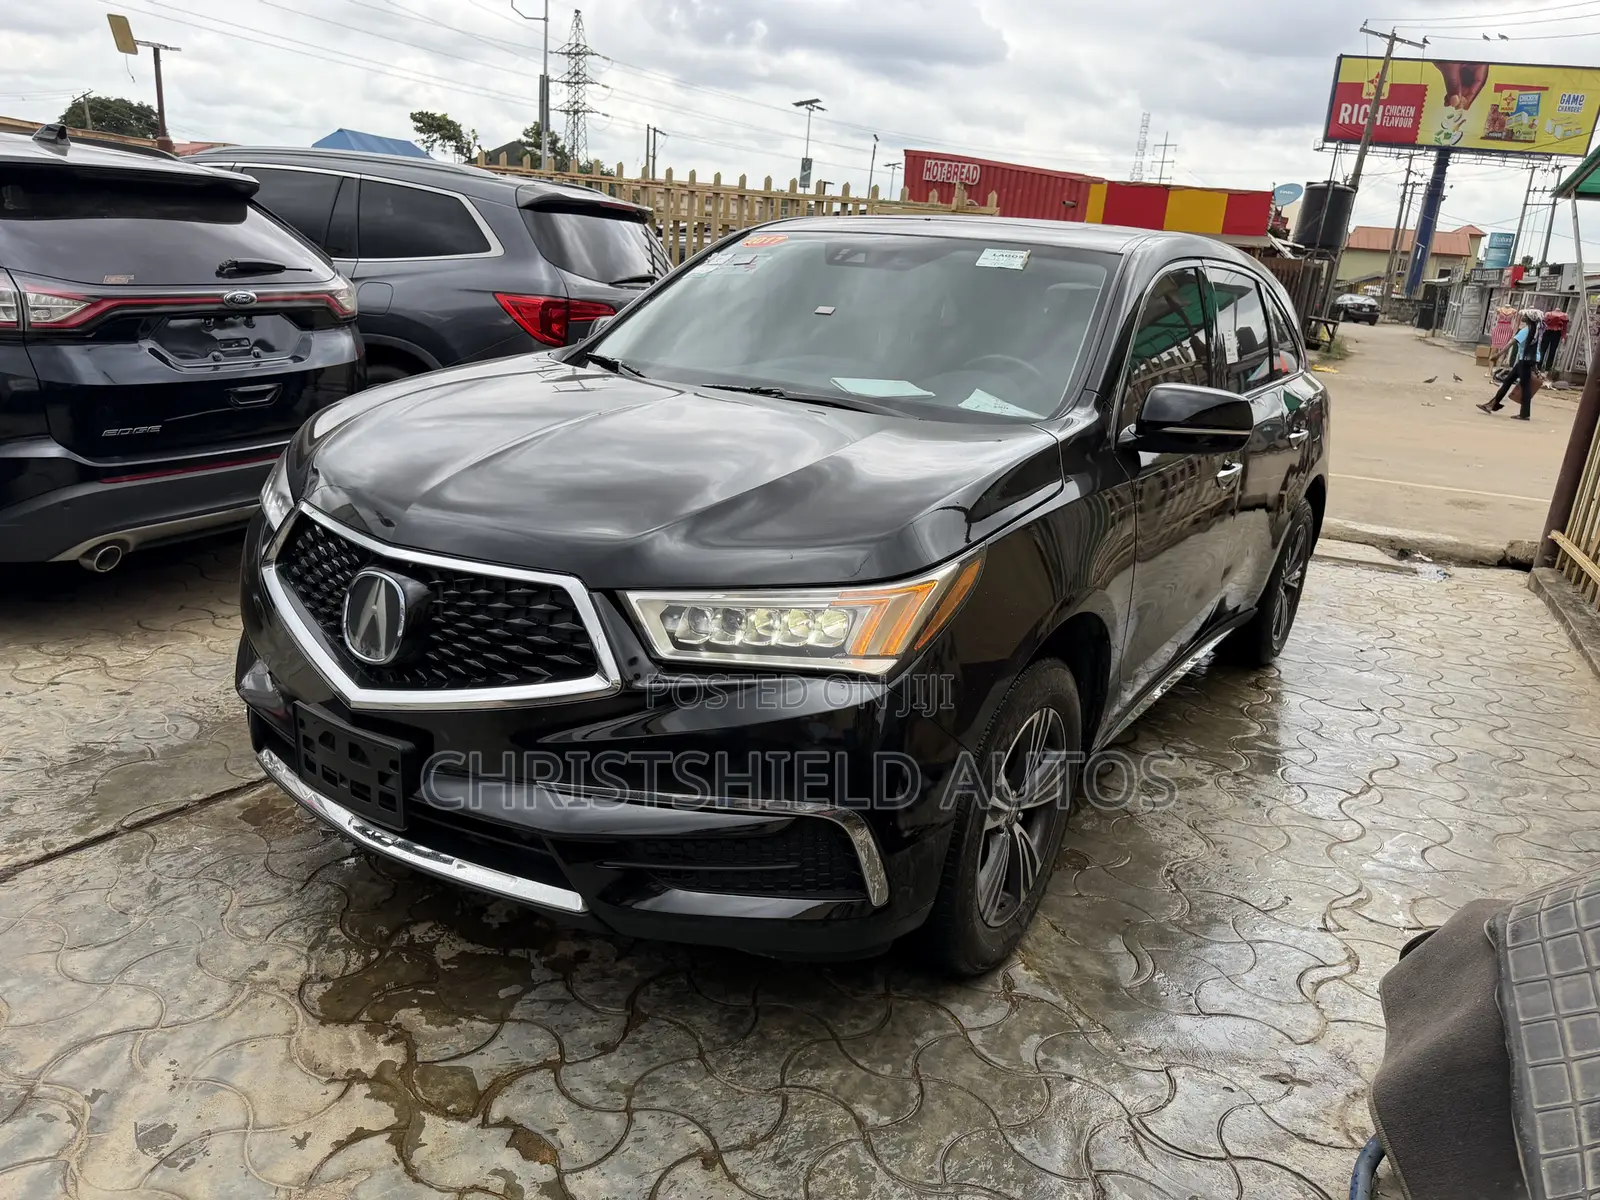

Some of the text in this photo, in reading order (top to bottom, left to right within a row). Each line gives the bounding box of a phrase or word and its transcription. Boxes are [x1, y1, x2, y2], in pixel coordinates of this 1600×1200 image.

[1384, 104, 1416, 118] CHICKEN
[1382, 116, 1413, 128] FLAVOUR
[234, 294, 252, 303] Ford
[101, 425, 162, 437] EDGE
